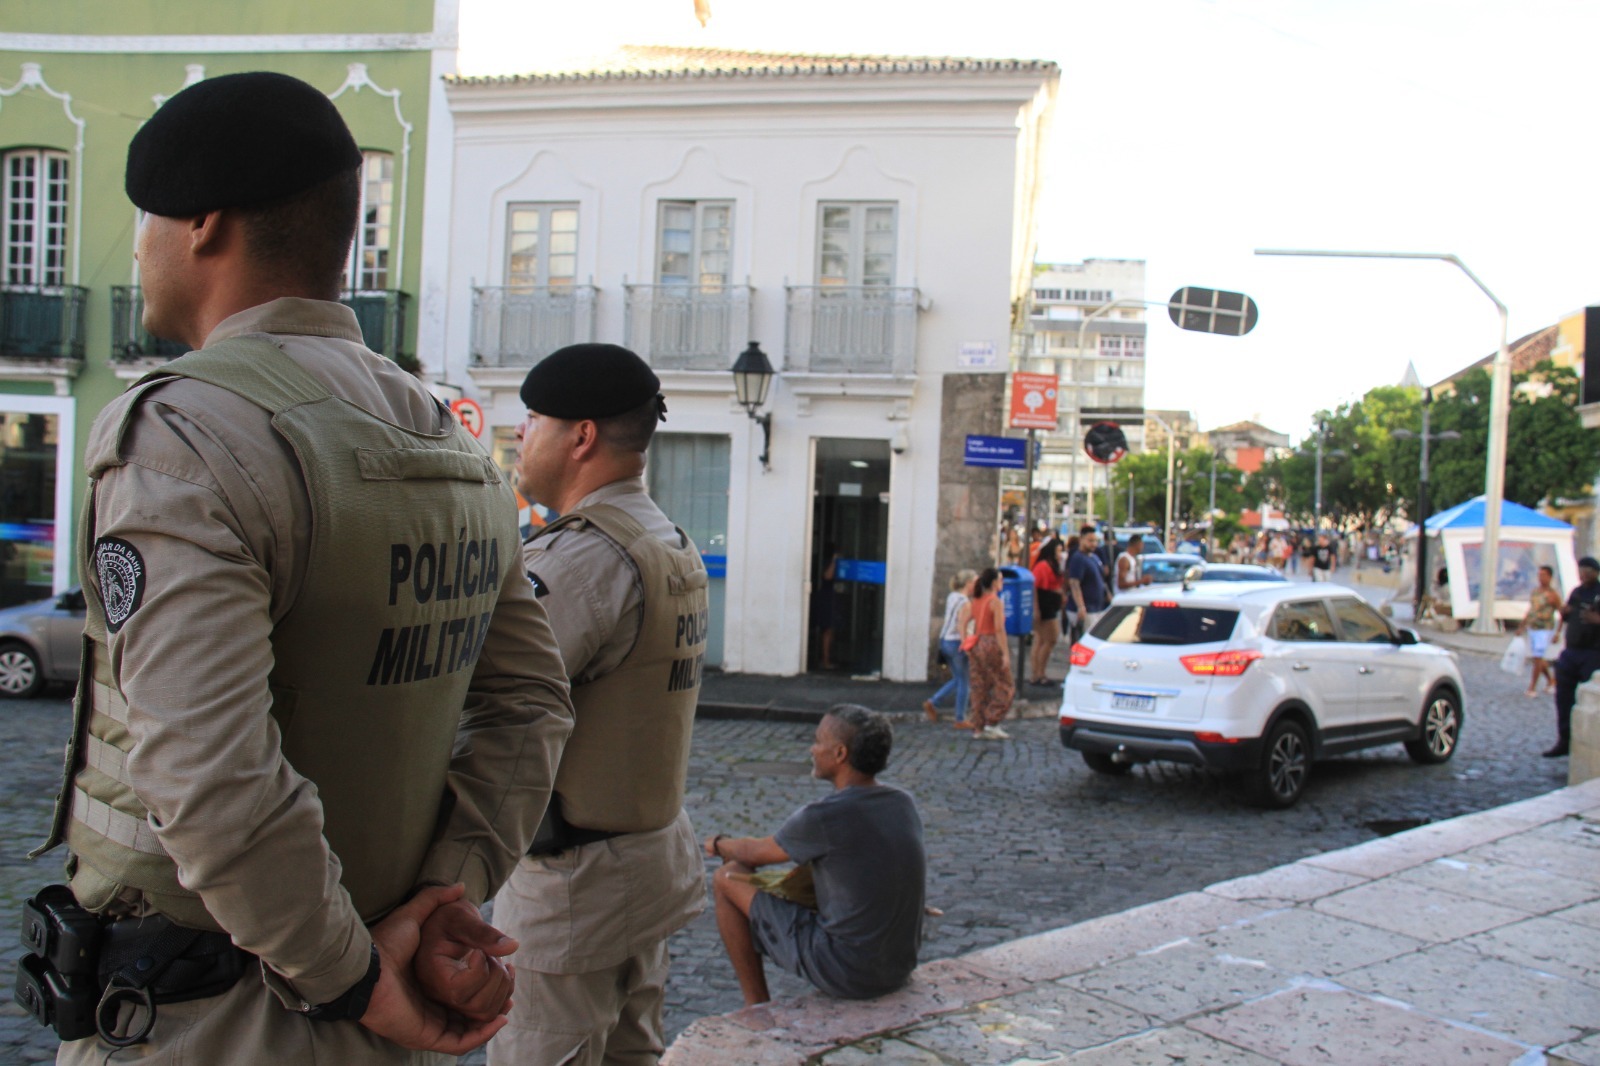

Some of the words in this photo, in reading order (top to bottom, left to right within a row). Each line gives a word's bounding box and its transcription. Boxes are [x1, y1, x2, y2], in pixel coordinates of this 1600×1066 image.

[114, 543, 125, 554] DA
[126, 550, 142, 578] BAHIA
[389, 527, 498, 605] POLÍCIA
